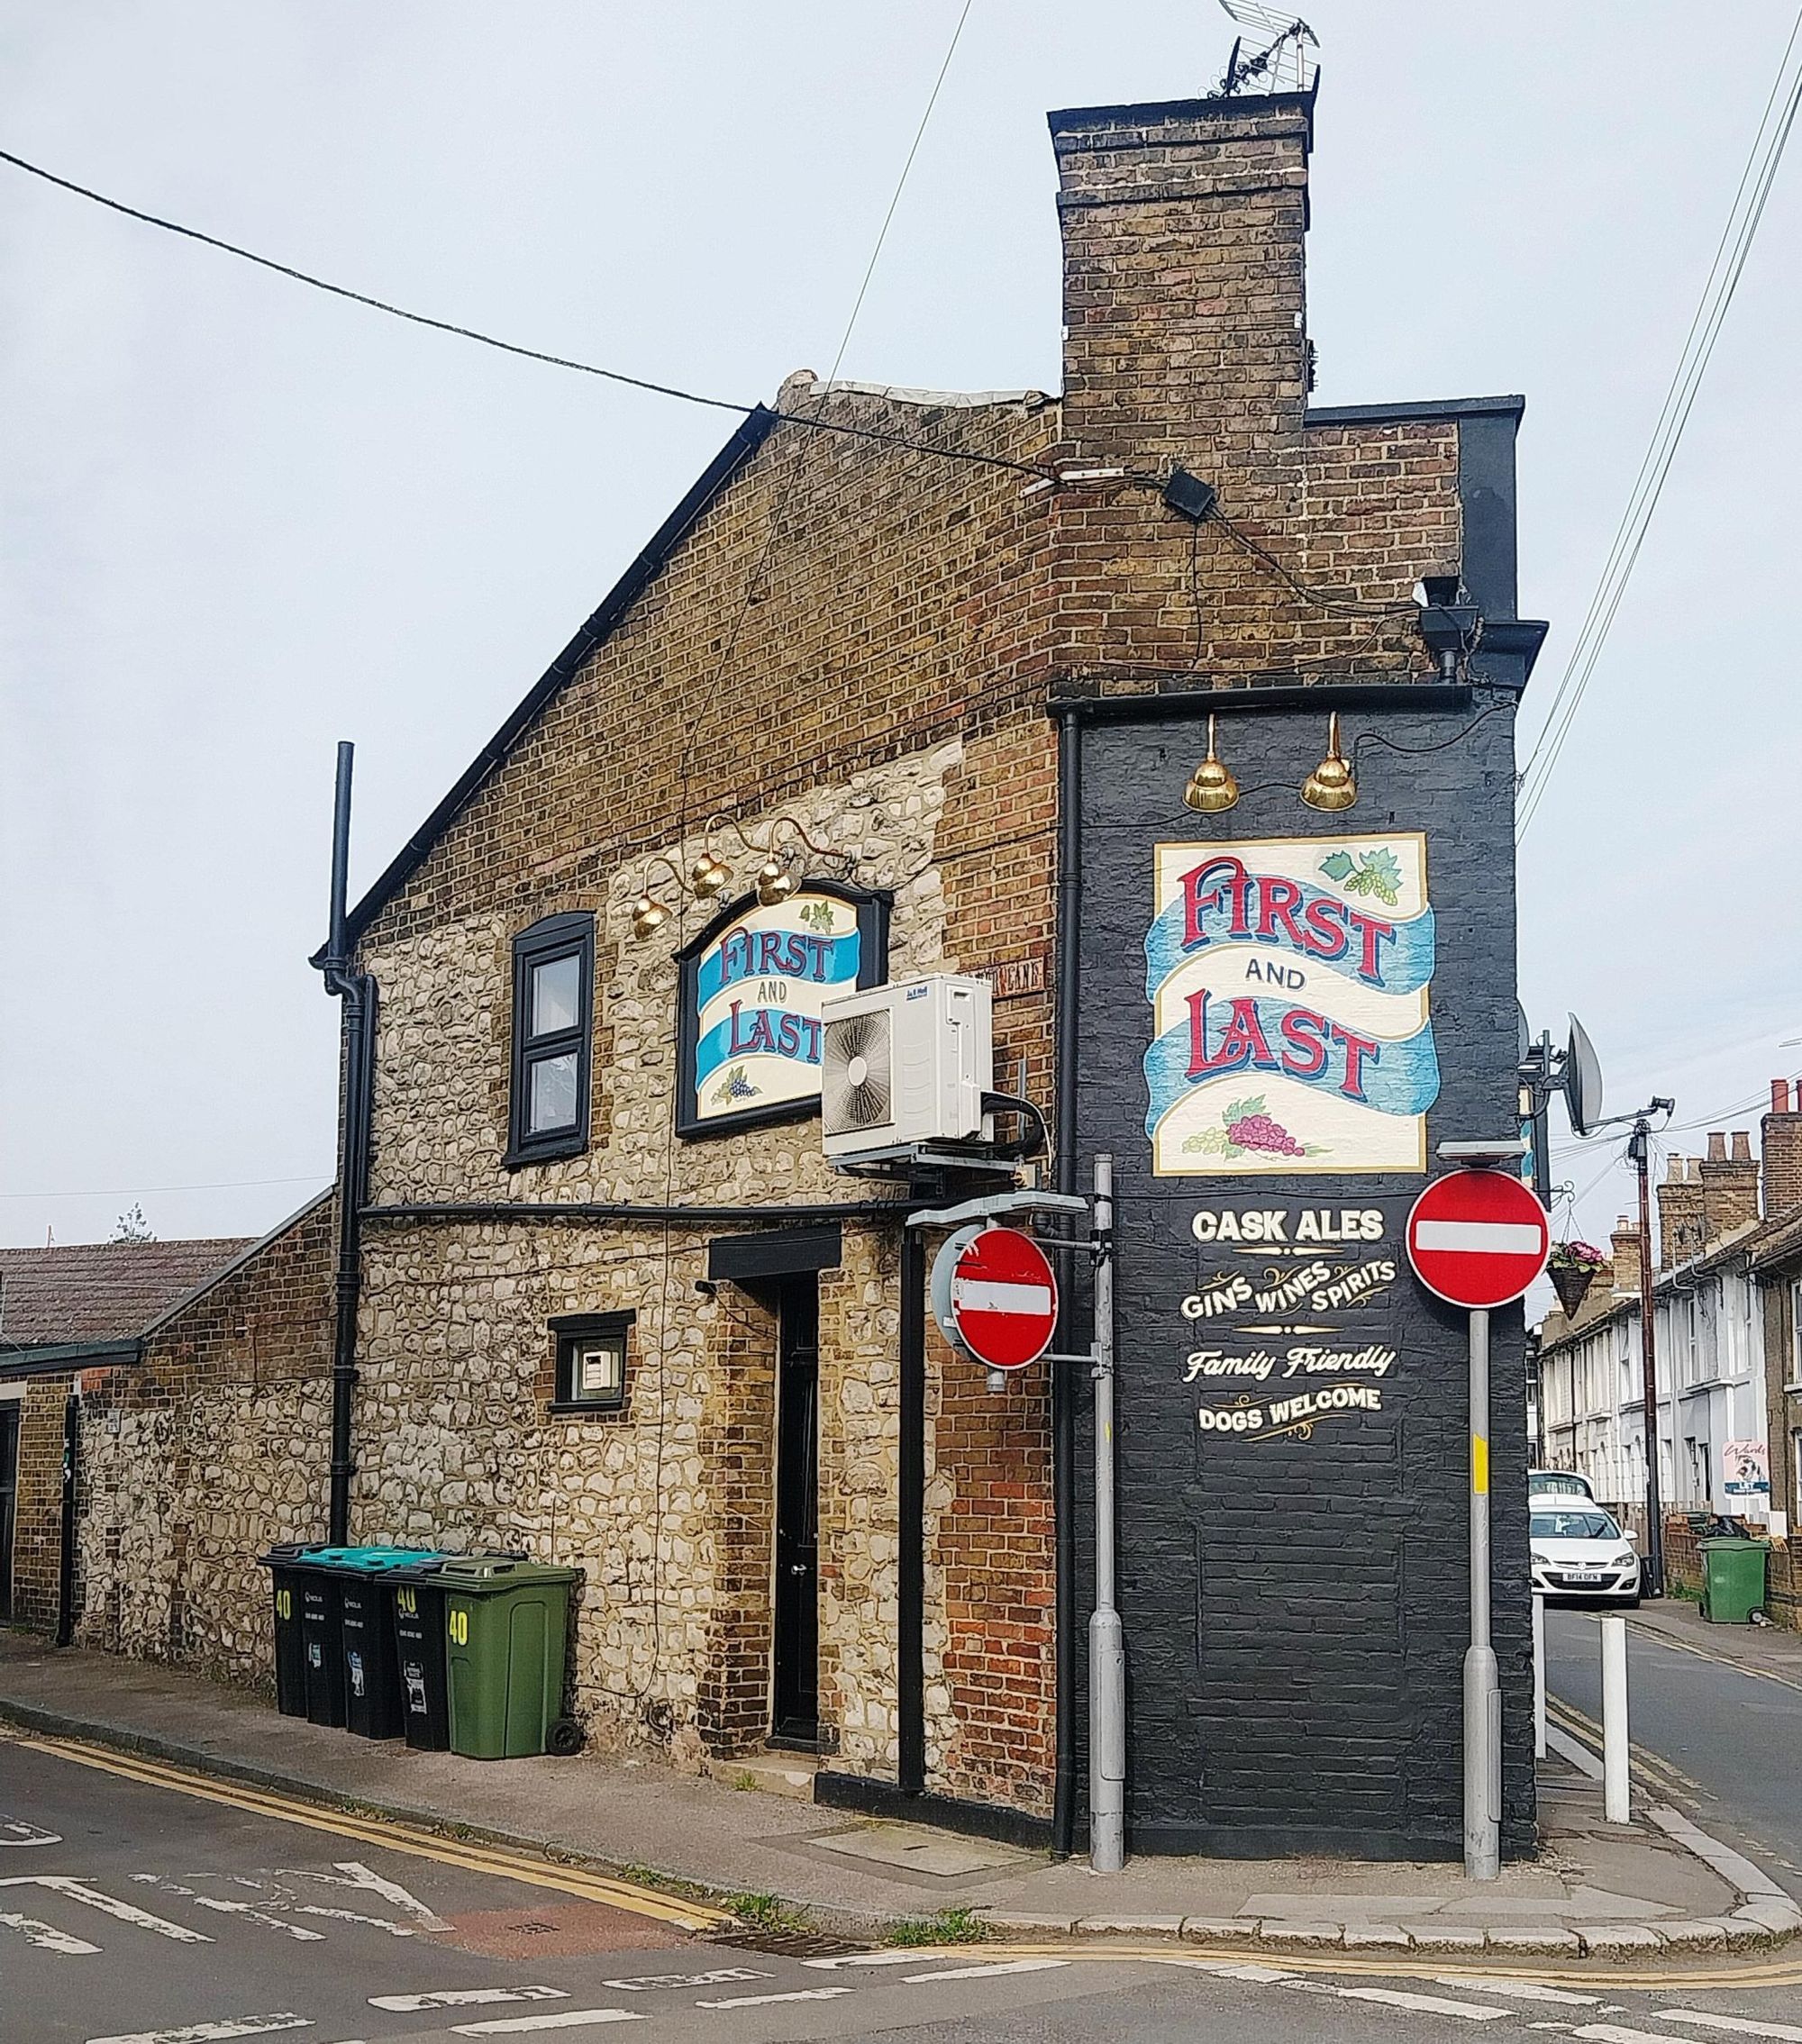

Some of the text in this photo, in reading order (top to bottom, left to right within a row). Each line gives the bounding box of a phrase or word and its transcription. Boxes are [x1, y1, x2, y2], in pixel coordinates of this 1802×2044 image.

[1177, 856, 1396, 986] FIRST
[720, 926, 834, 984] FIRST
[757, 981, 787, 1004] AND
[1245, 958, 1306, 990] AND
[729, 999, 822, 1064] LAST
[1184, 988, 1382, 1102] LAST
[1191, 1209, 1385, 1242] CASK ALES
[1179, 1260, 1397, 1320] GINS WINES SPIRITS
[1182, 1345, 1397, 1382] Family Friendly
[1198, 1387, 1382, 1432] DOGS WELCOME
[276, 1589, 291, 1620] 40
[397, 1585, 416, 1612] 40
[449, 1610, 469, 1646] 40
